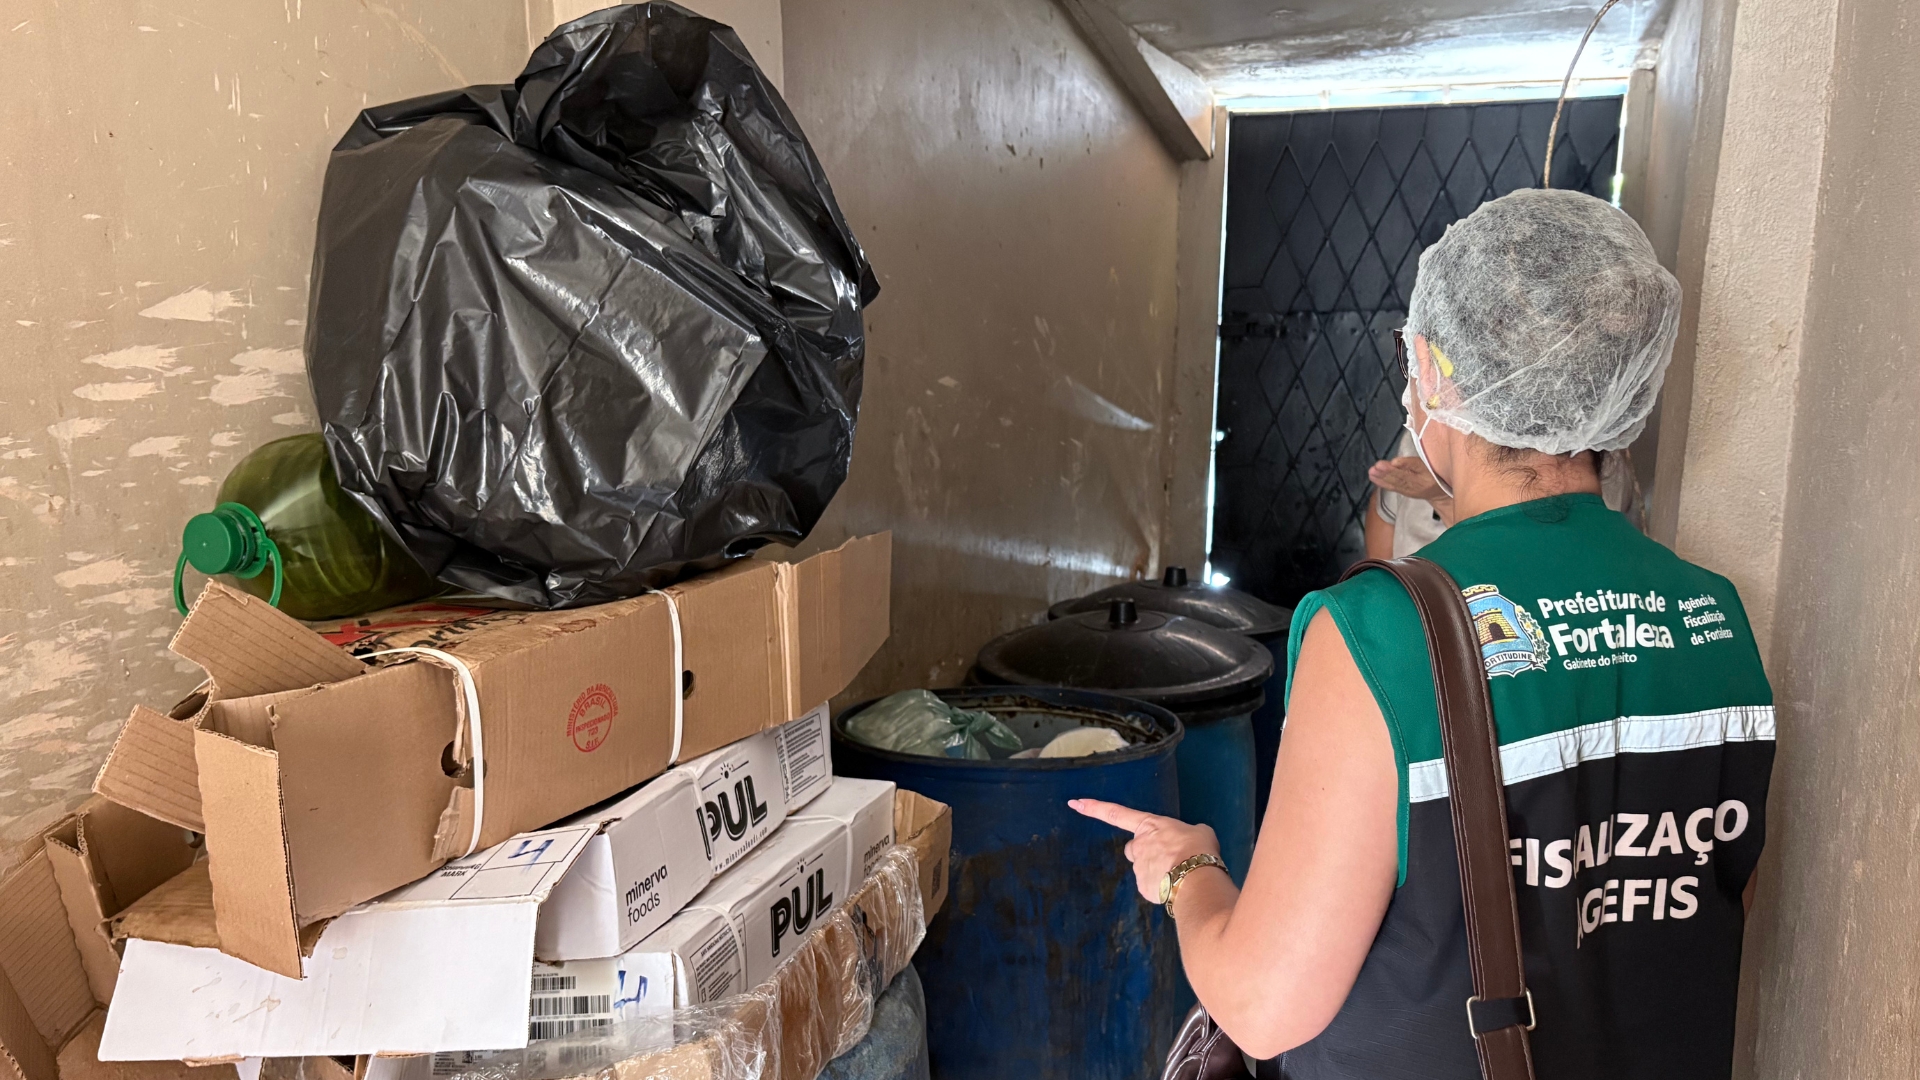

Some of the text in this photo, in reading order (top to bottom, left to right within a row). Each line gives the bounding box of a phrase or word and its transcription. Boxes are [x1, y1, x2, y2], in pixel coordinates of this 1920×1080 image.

[1644, 590, 1666, 613] de
[1547, 613, 1675, 656] Fortaleza
[1690, 632, 1705, 646] de
[1484, 653, 1533, 668] ORTITUDINE
[1563, 657, 1597, 671] Gabinete
[1598, 655, 1611, 667] do
[579, 696, 606, 718] BRASIL
[696, 775, 768, 861] PUL
[864, 834, 890, 863] minerva
[441, 870, 468, 878] MARK
[625, 864, 668, 906] minerva
[627, 890, 661, 927] foods
[771, 868, 833, 958] PUL
